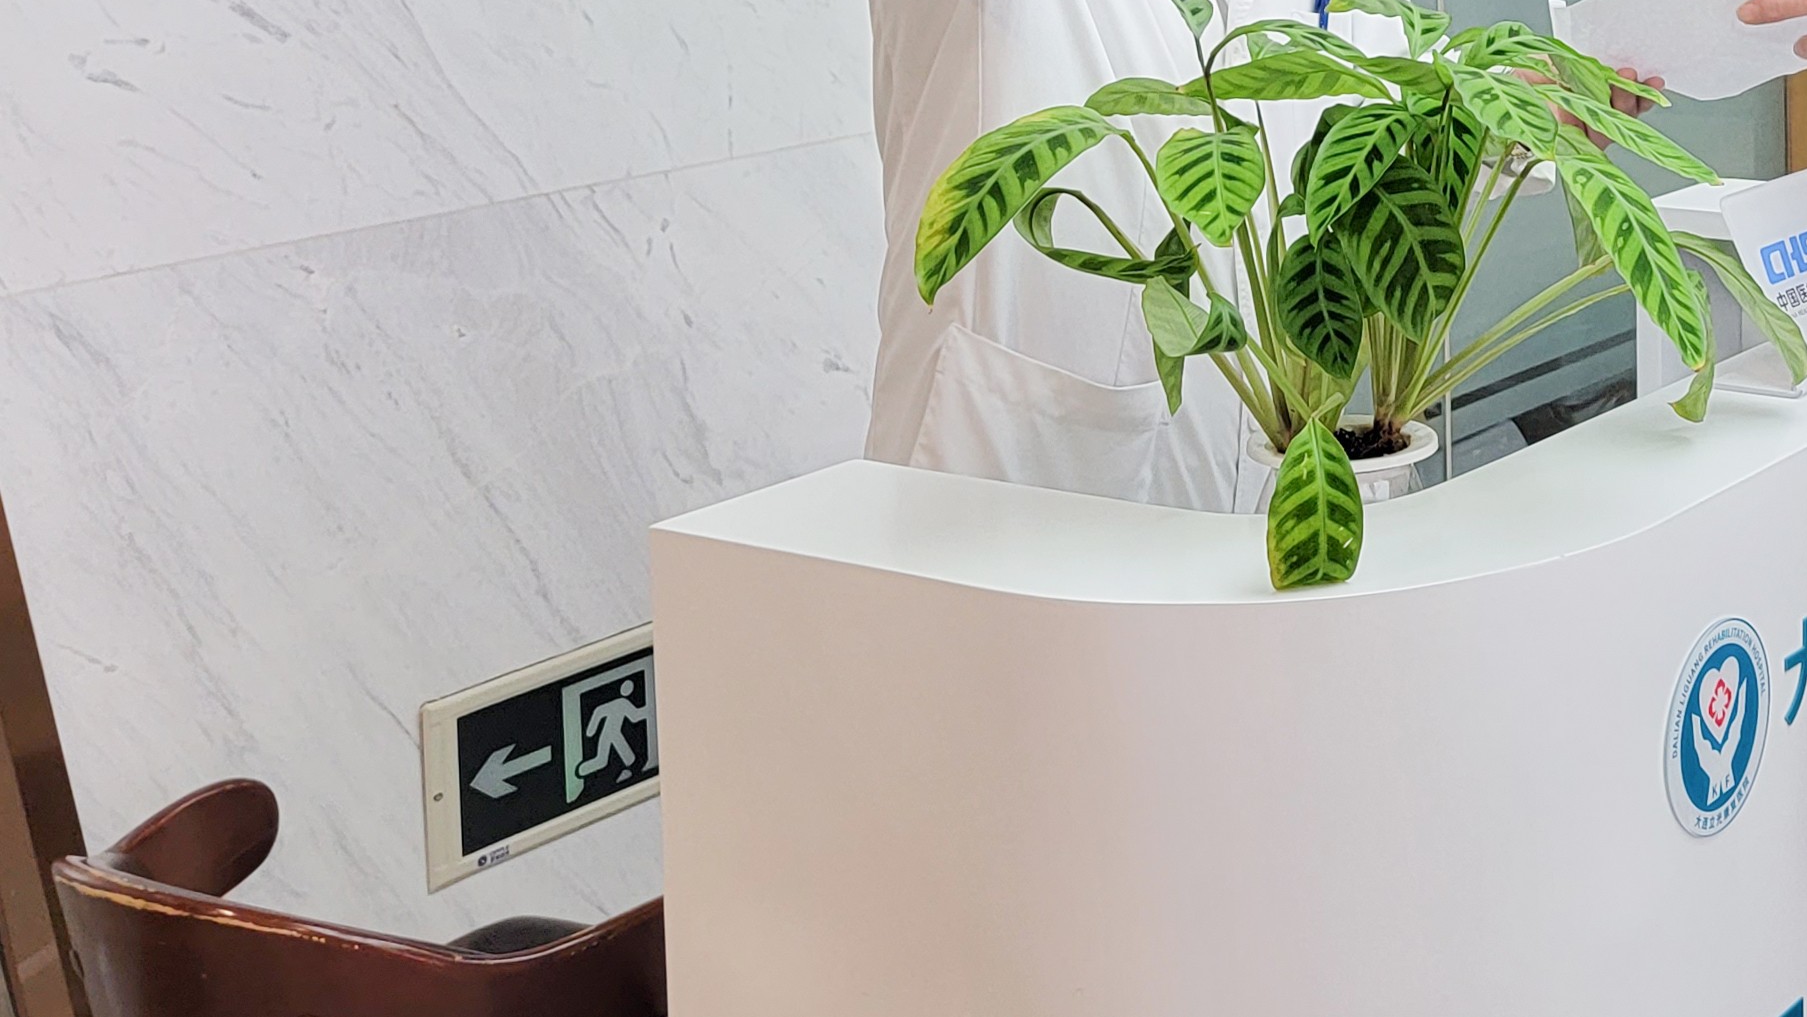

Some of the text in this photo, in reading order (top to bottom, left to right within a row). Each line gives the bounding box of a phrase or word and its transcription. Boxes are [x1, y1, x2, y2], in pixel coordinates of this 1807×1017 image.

[1672, 626, 1767, 760] DALIAN LIGUANG REHABILITATION HOSPITAL
